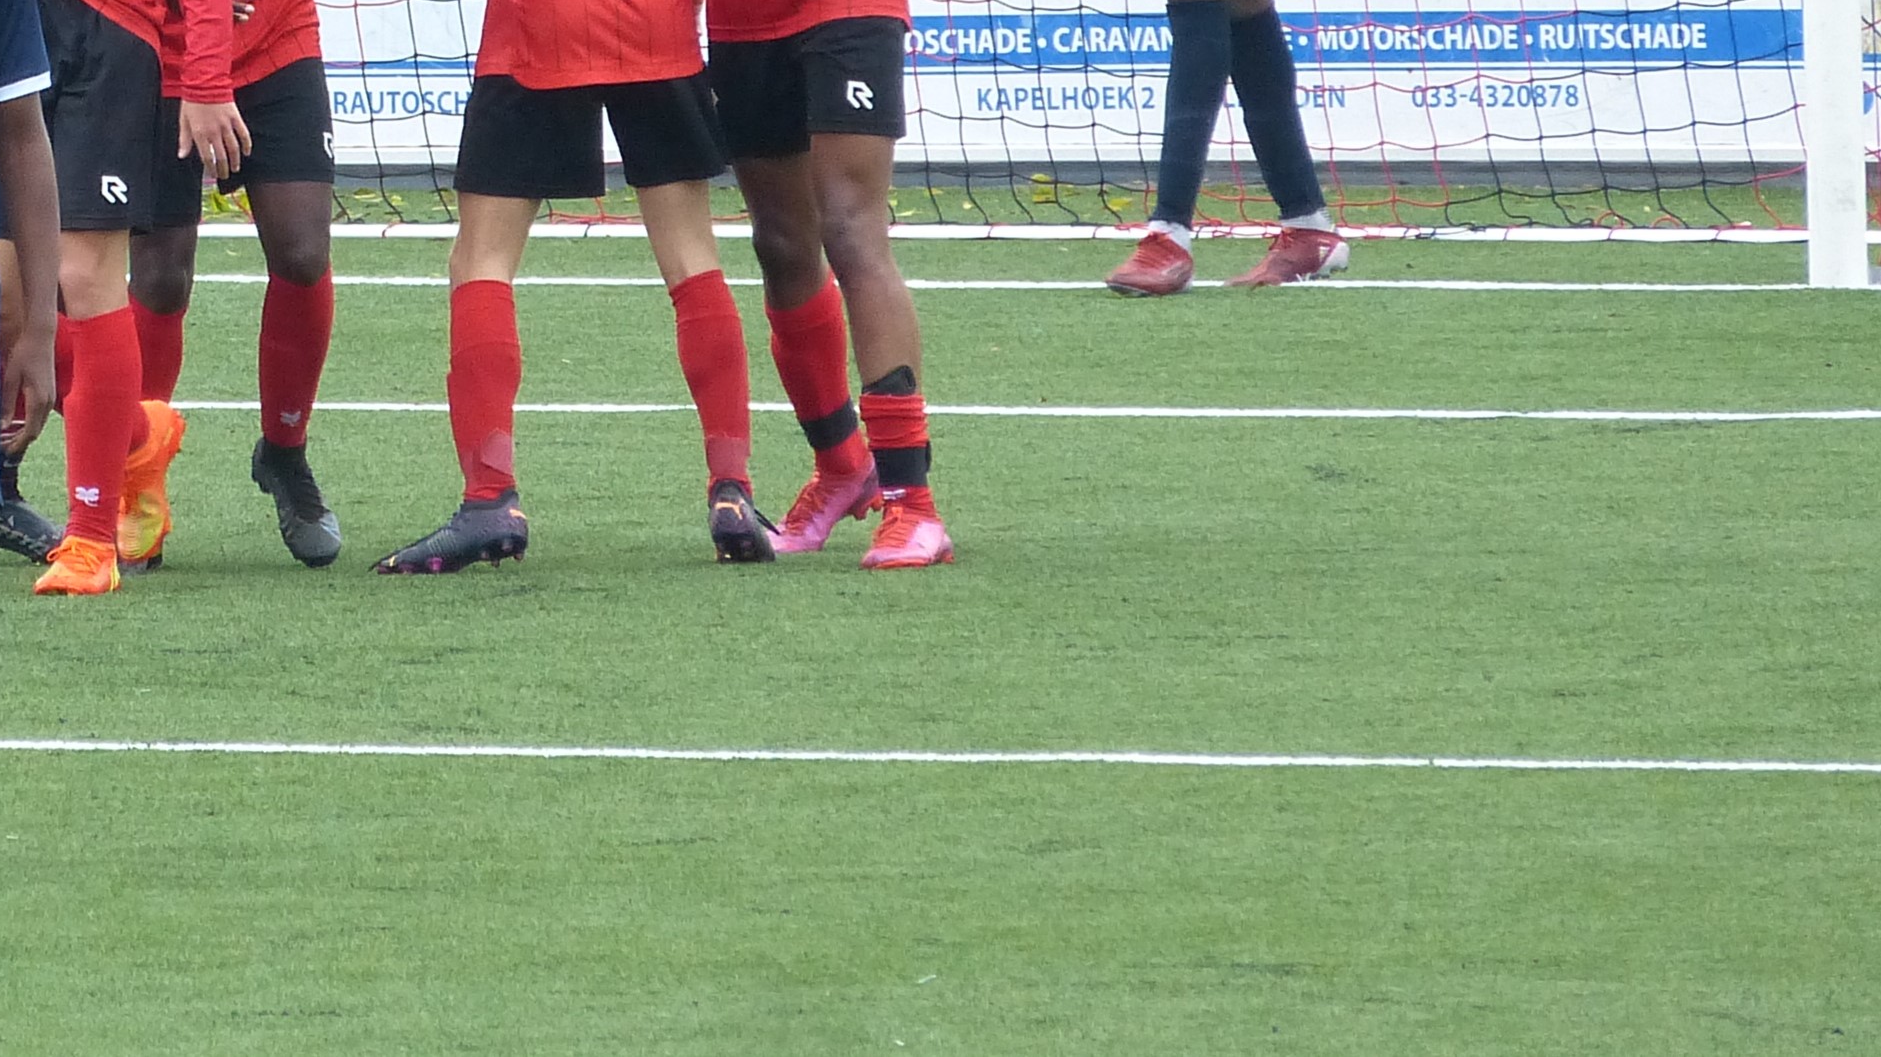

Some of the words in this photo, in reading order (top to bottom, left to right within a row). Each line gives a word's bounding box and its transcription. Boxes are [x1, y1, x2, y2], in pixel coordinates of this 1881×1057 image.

[904, 28, 1032, 54] OSCHADE
[1317, 22, 1519, 51] MOTORSCHADE
[1540, 22, 1708, 50] RUITSCHADE
[977, 86, 1133, 111] KAPELHOEK
[1141, 86, 1156, 110] 2
[1412, 84, 1580, 109] 033-4320878
